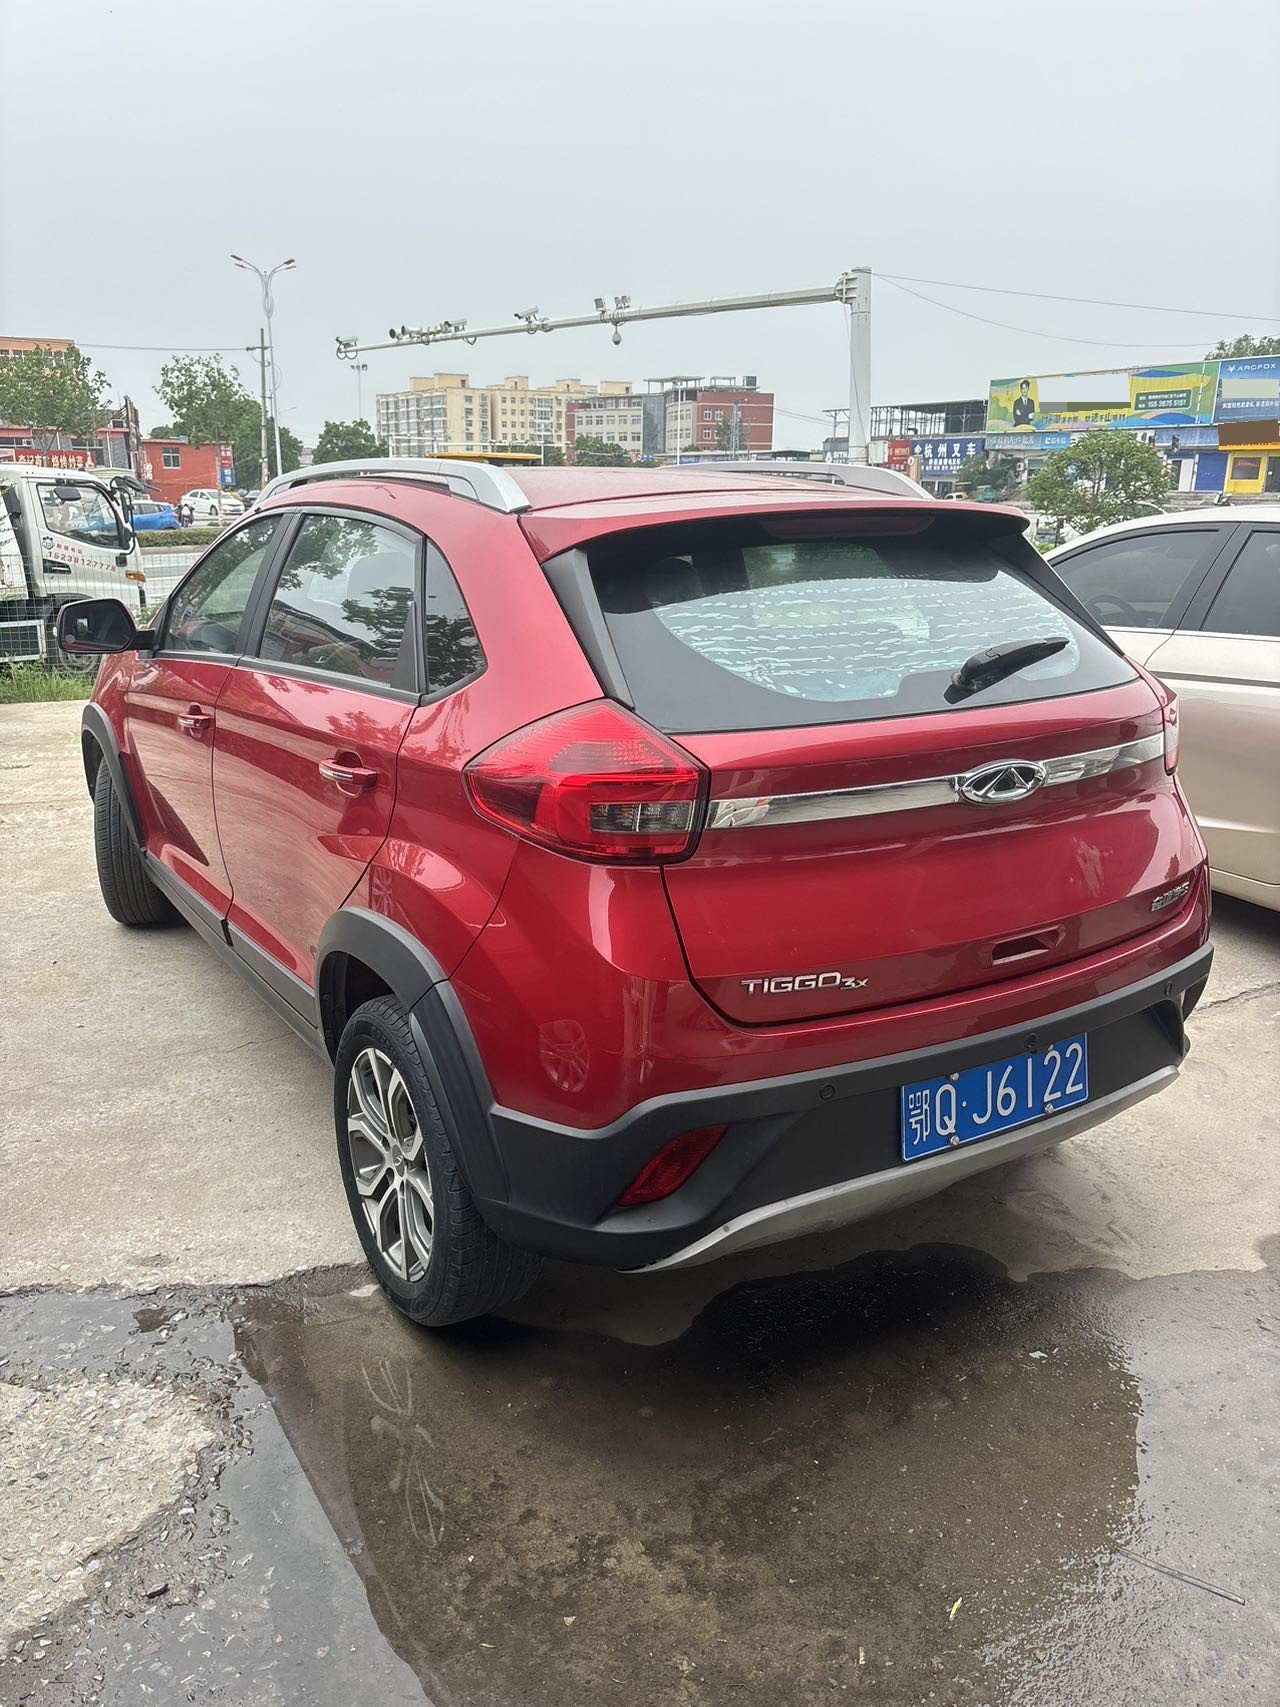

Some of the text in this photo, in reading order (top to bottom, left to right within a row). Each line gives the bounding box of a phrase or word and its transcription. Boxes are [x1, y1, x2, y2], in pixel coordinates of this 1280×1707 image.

[1236, 363, 1277, 371] ARCFOX
[924, 442, 977, 458] 杭州叉车
